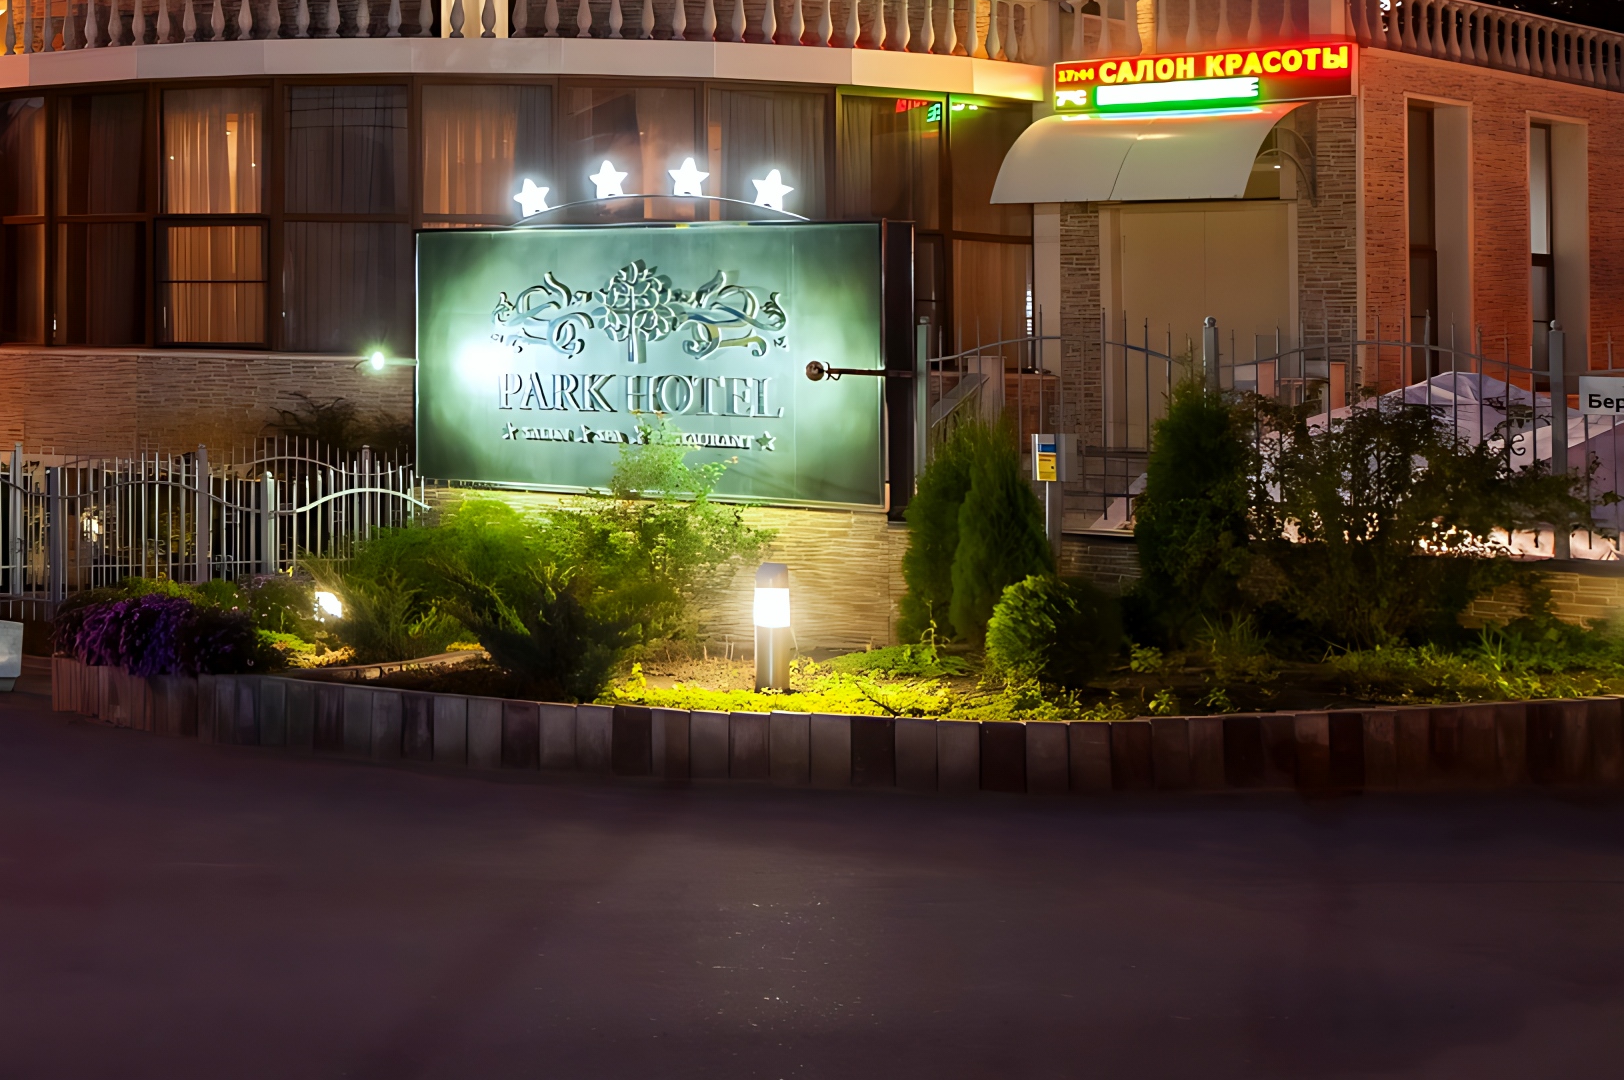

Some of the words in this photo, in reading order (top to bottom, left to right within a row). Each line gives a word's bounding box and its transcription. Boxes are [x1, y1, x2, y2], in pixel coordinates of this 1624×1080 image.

[1099, 56, 1196, 84] САЛОН
[1205, 46, 1349, 78] КРАСОТЫ
[497, 372, 618, 413] PARK
[623, 374, 785, 419] HOTEL
